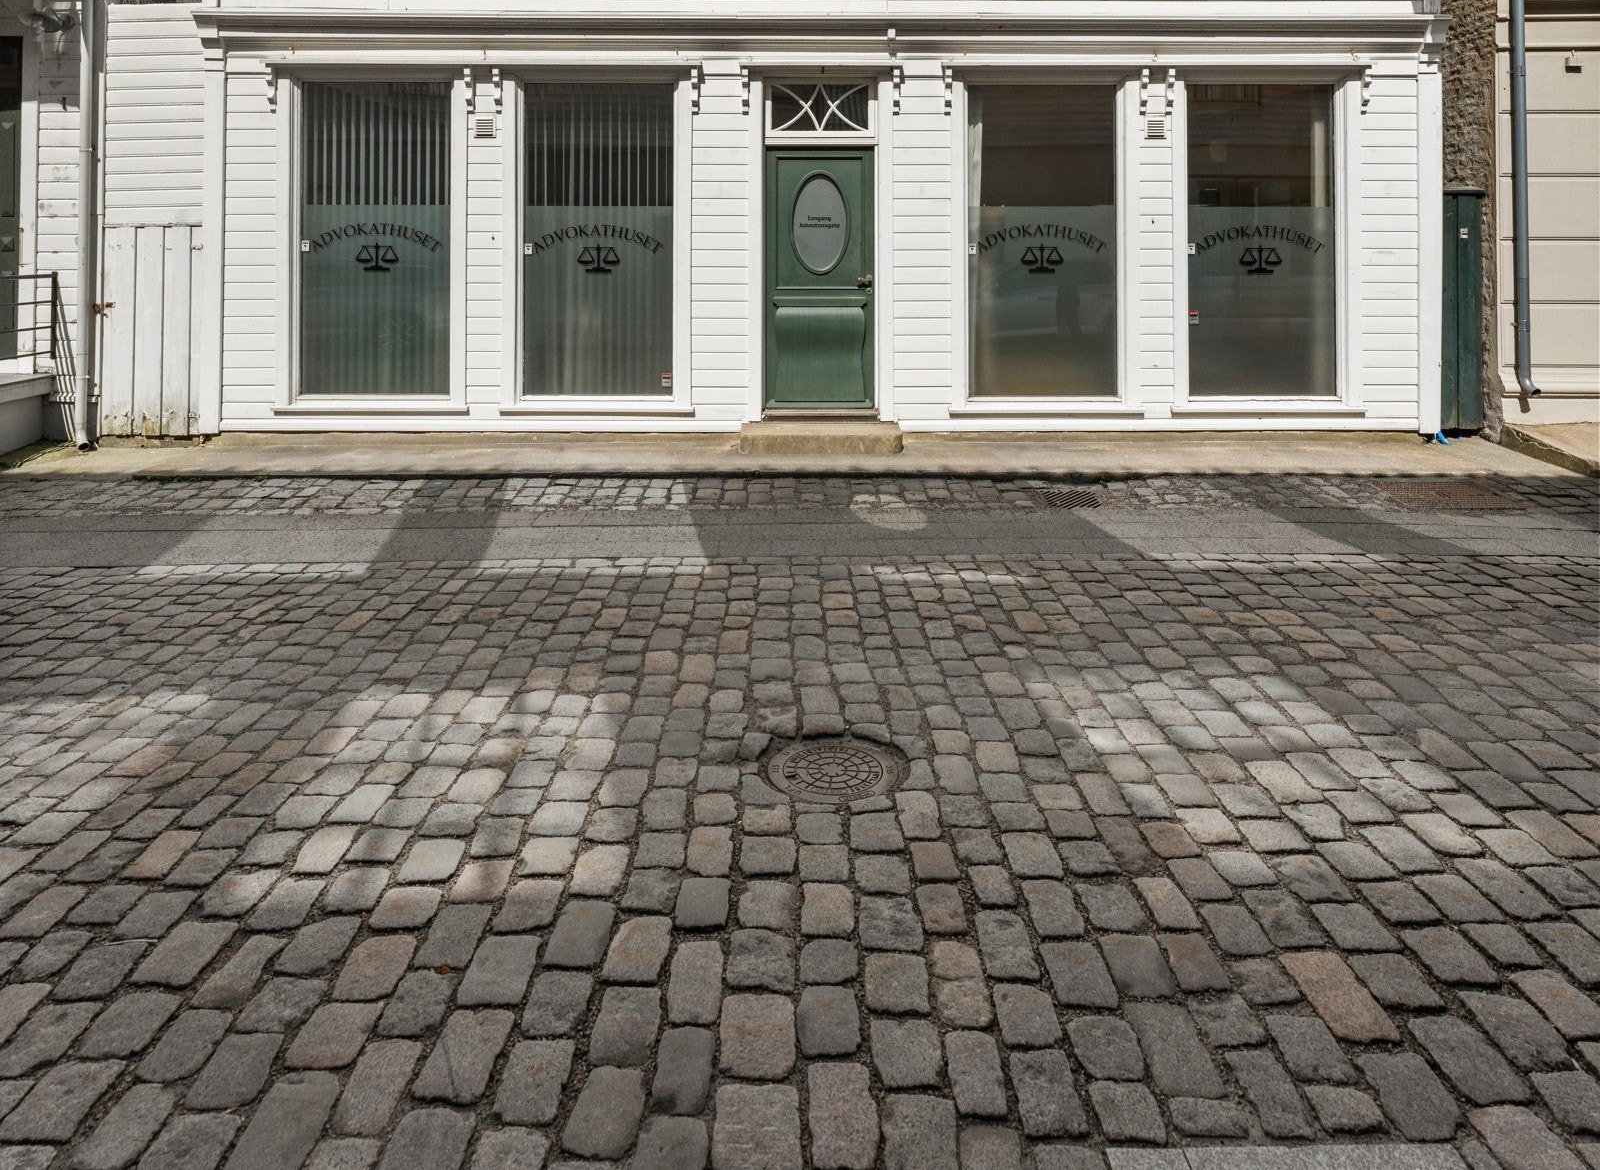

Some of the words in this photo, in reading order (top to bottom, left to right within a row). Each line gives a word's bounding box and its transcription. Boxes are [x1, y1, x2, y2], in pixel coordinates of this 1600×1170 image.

[310, 222, 443, 255] ADVOKATHUSET
[532, 223, 664, 256] ADVOKATHUSET
[977, 223, 1108, 255] ADVOKATHUSET
[1196, 224, 1326, 256] ADVOKATHUSET
